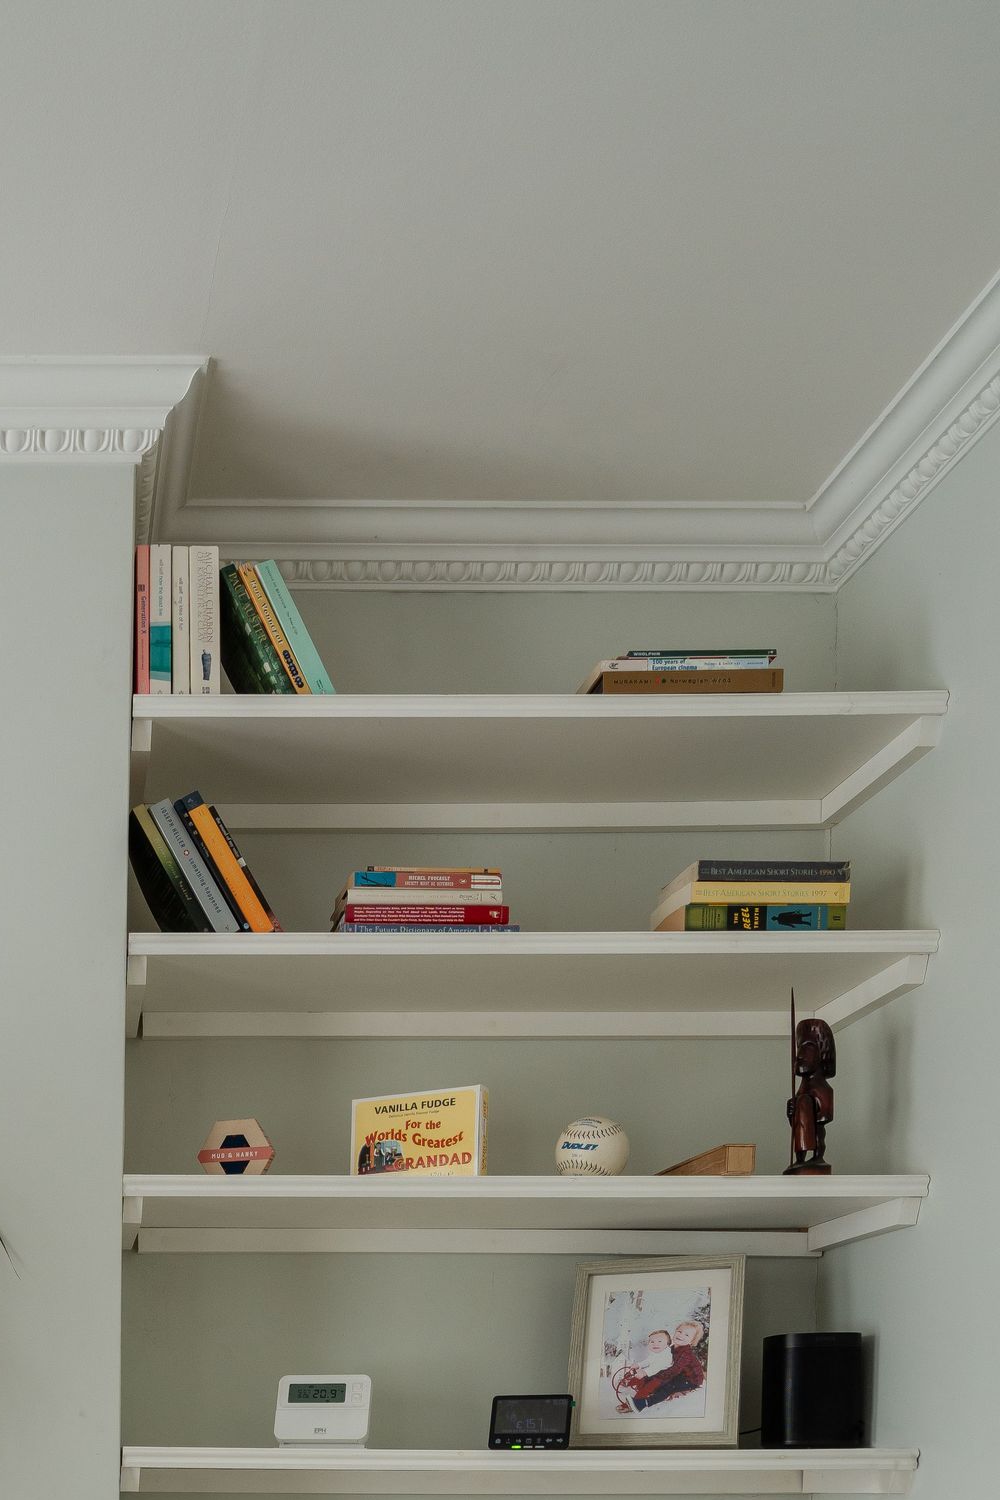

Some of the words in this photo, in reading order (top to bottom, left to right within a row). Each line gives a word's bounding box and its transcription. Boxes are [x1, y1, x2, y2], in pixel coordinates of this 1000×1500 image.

[227, 572, 249, 599] PAUL
[242, 602, 268, 644] AUSTER
[160, 806, 174, 827] JOSEPH
[170, 826, 186, 849] HELLER
[710, 868, 727, 876] BEST
[728, 868, 766, 876] AMERICAN
[767, 868, 790, 876] SHORT
[790, 868, 818, 876] STORIES
[702, 889, 719, 897] BEST
[719, 889, 757, 897] AMERICAN
[758, 889, 781, 897] SHORT
[781, 889, 809, 897] STORIES
[810, 889, 828, 897] 1997
[743, 907, 751, 930] REEL
[400, 925, 437, 933] Dictionary
[374, 1102, 418, 1115] VANILLA
[421, 1097, 456, 1109] FUDGE
[405, 1120, 422, 1130] For
[425, 1119, 441, 1130] the
[365, 1128, 407, 1146] Worlds
[412, 1131, 464, 1149] Greatest
[561, 1141, 599, 1151] DUDLEY
[393, 1152, 472, 1171] GRANDAD
[312, 1389, 337, 1399] 20.9
